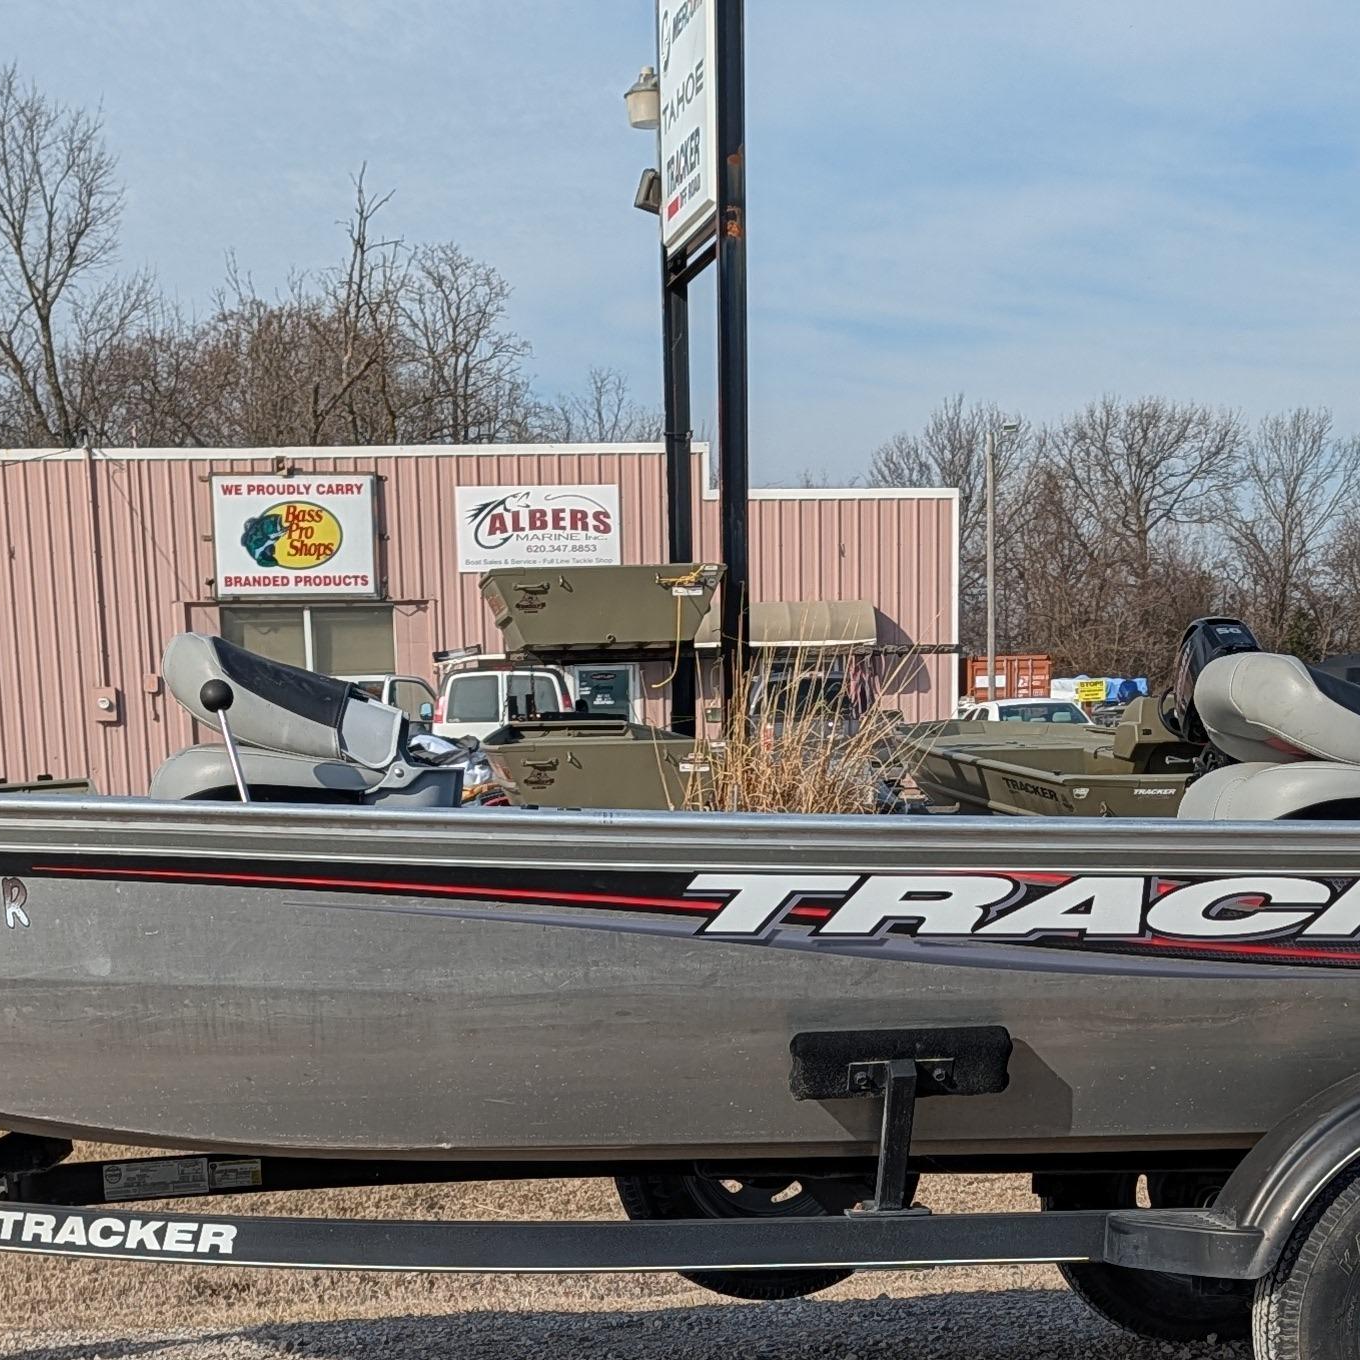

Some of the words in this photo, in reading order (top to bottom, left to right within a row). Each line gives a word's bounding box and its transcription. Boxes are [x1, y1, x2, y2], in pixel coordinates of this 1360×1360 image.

[662, 58, 704, 135] TAHOE
[666, 126, 700, 198] TRACKER
[221, 484, 243, 495] WE
[247, 483, 312, 495] PROUDLY
[316, 483, 364, 495] CARRY
[285, 505, 323, 523] Bass
[487, 508, 612, 536] ALBERS
[287, 522, 315, 539] Pro
[515, 532, 580, 541] MARINE
[287, 539, 335, 560] Shops
[526, 544, 597, 553] 620.347.8853
[224, 575, 290, 587] BRANDED
[294, 575, 369, 587] PRODUCTS
[1001, 776, 1059, 802] TRACKER
